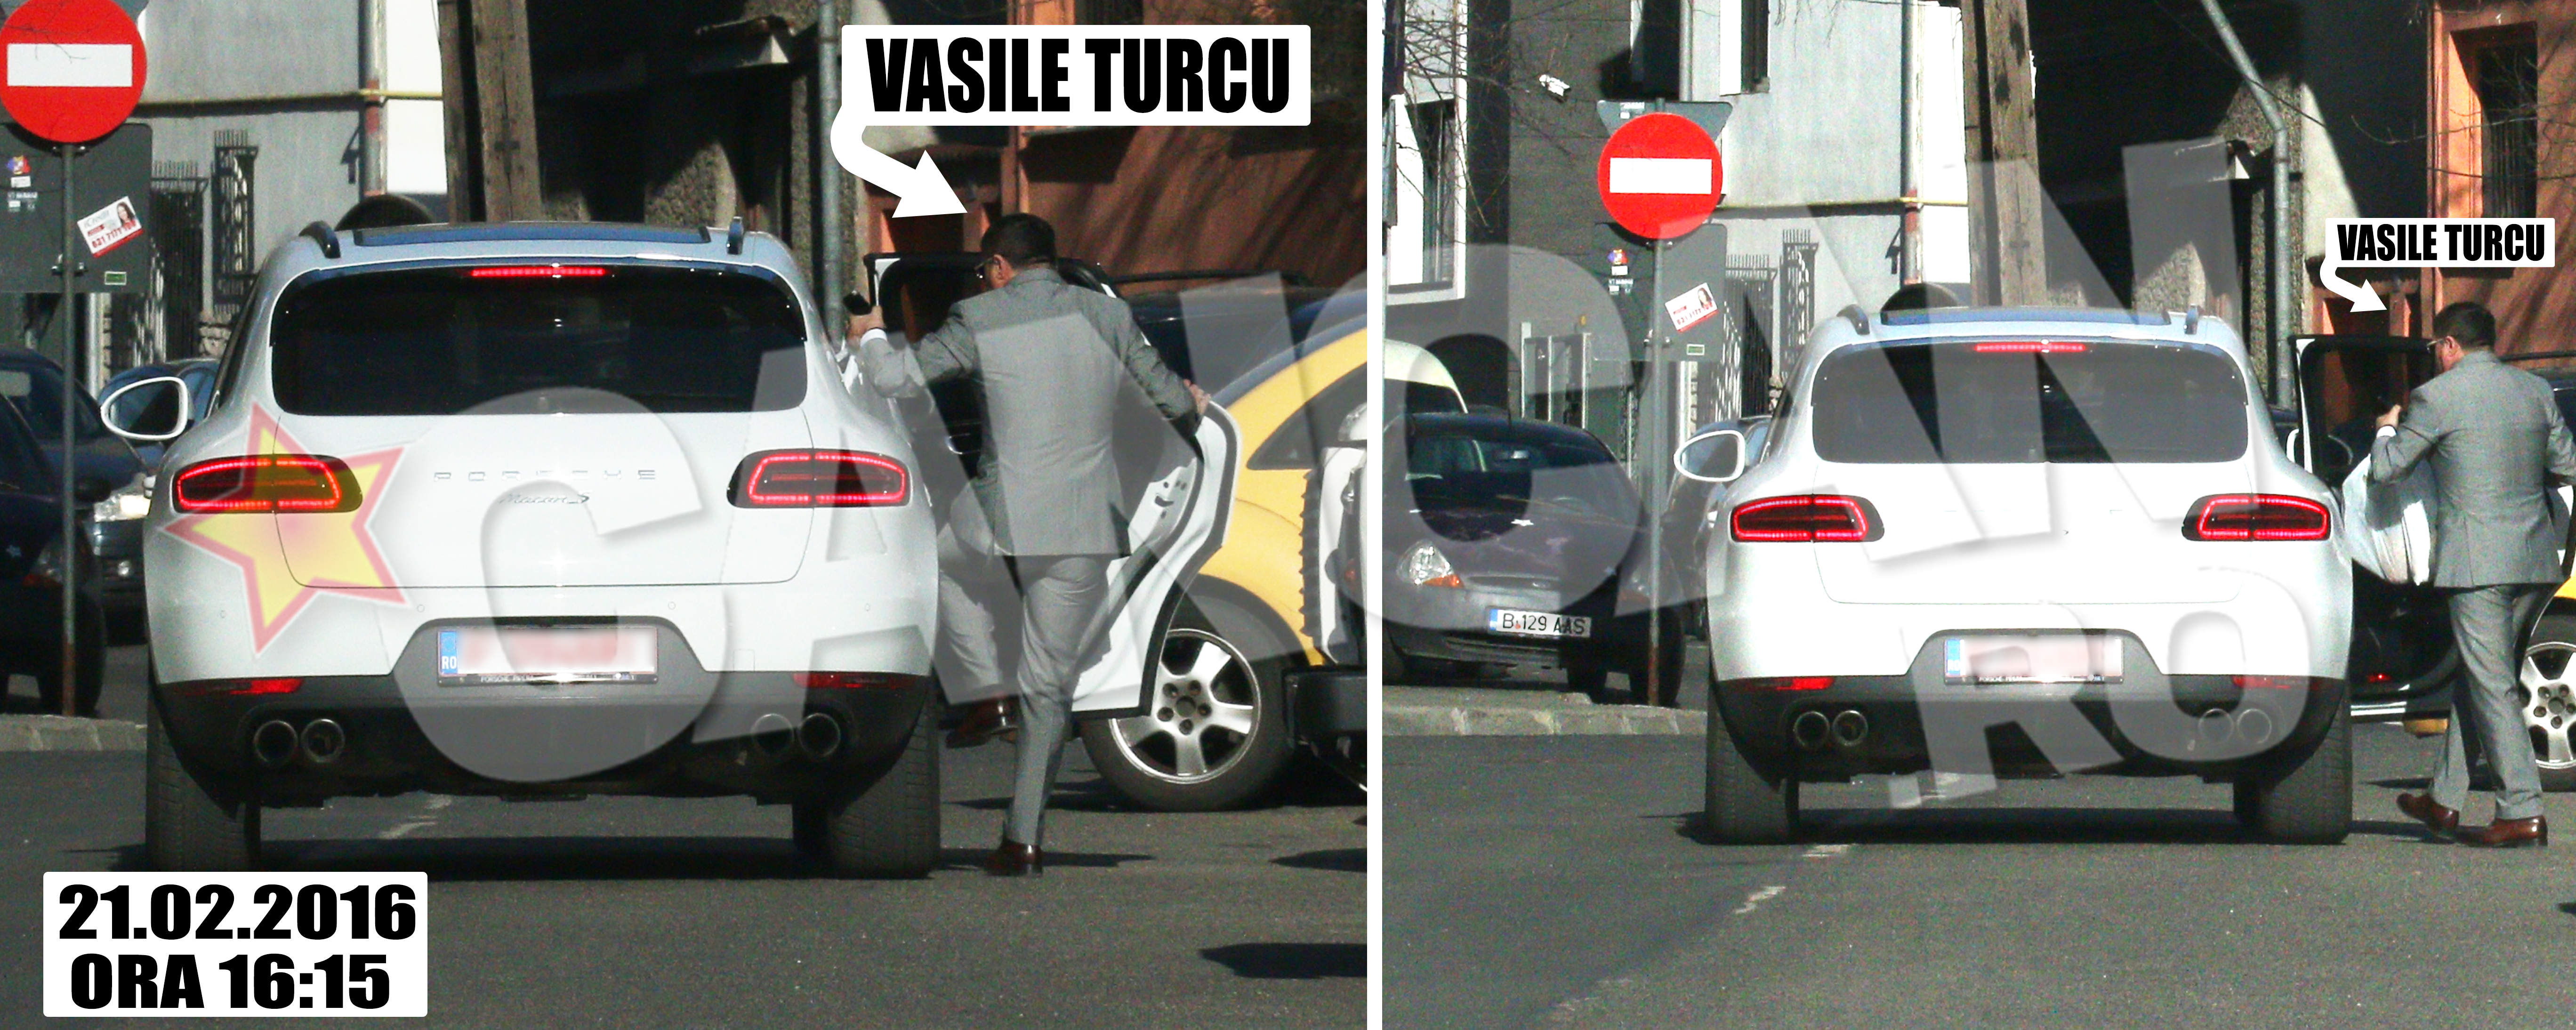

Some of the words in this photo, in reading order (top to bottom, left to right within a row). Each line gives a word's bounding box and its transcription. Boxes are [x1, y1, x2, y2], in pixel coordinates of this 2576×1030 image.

[1503, 613, 1514, 628] B
[1522, 614, 1546, 631] 129
[1554, 617, 1585, 634] AAS
[442, 656, 457, 669] RO
